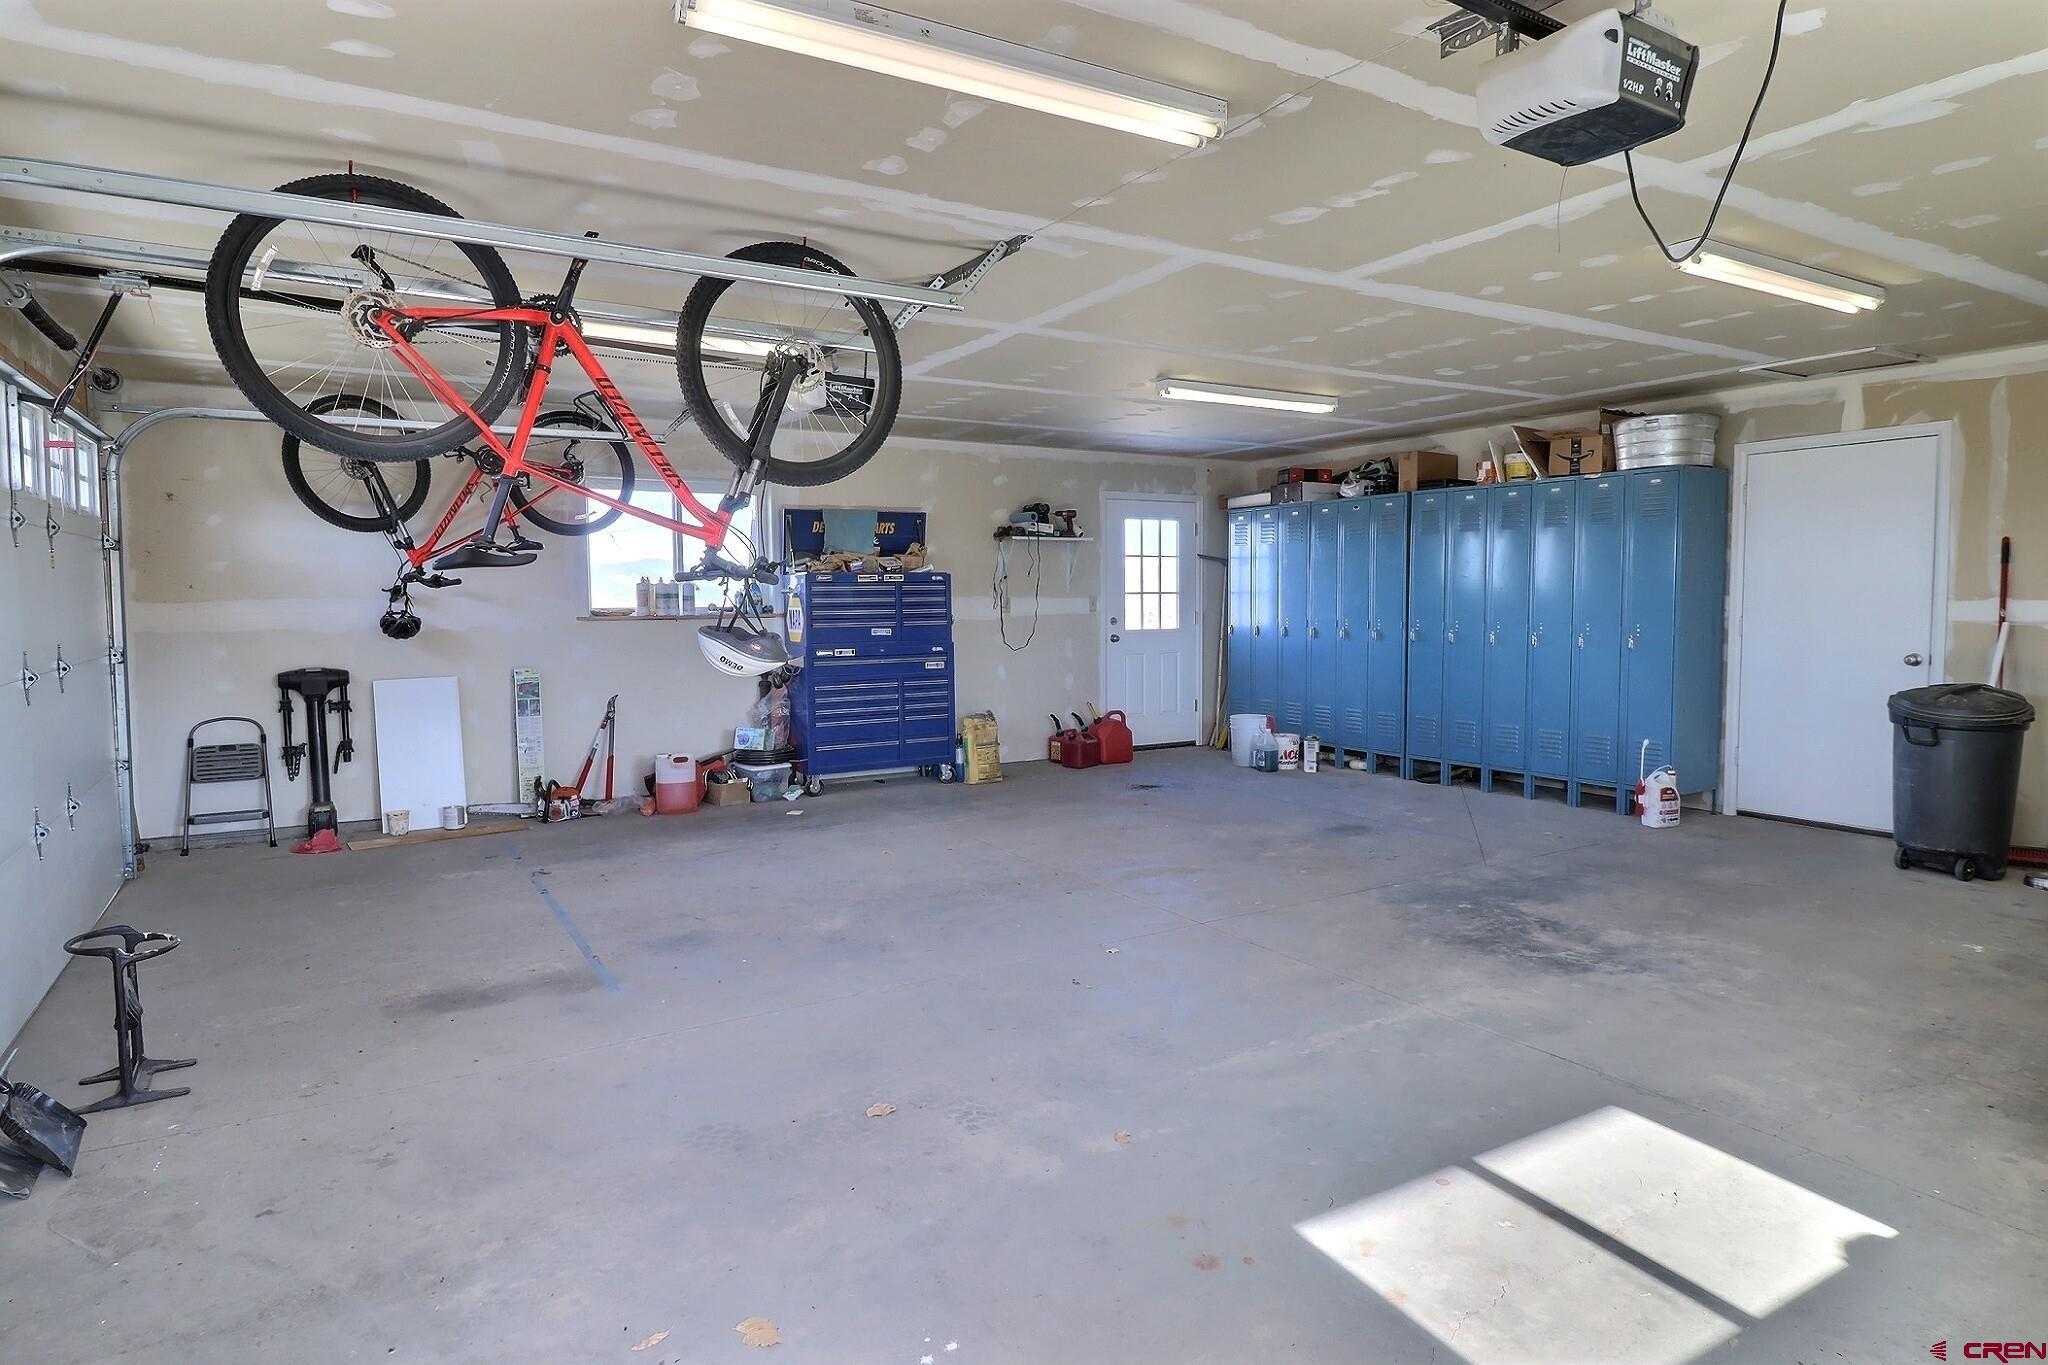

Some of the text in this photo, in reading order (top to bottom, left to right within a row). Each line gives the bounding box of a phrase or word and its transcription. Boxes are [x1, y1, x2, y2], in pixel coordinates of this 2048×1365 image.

[1626, 42, 1681, 76] LiftMaster
[595, 377, 685, 490] SPECIALIZED
[719, 655, 744, 672] DEMO
